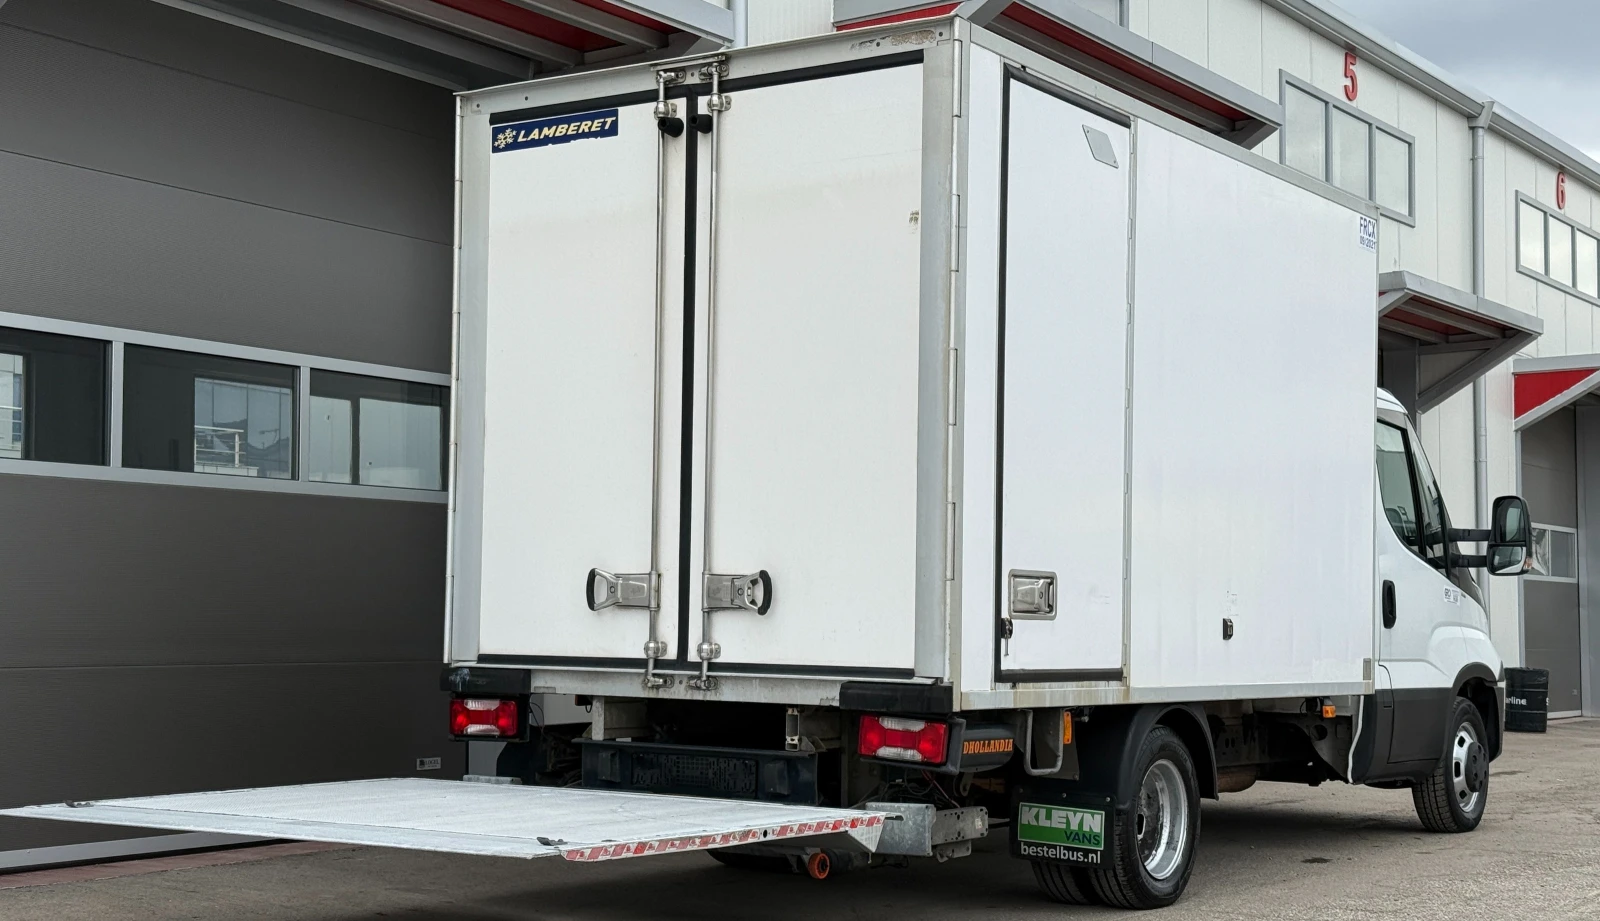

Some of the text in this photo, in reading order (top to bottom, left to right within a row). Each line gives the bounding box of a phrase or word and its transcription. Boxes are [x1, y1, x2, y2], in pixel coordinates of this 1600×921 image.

[1343, 51, 1358, 101] 5
[517, 117, 616, 142] LAMBERET
[1556, 171, 1566, 210] 6
[1360, 216, 1376, 240] FRCX
[963, 739, 1013, 754] DHOLLANDIA
[1021, 806, 1101, 833] KLEYN
[1064, 830, 1100, 846] VANS
[1021, 842, 1100, 864] bestelbus.nl
